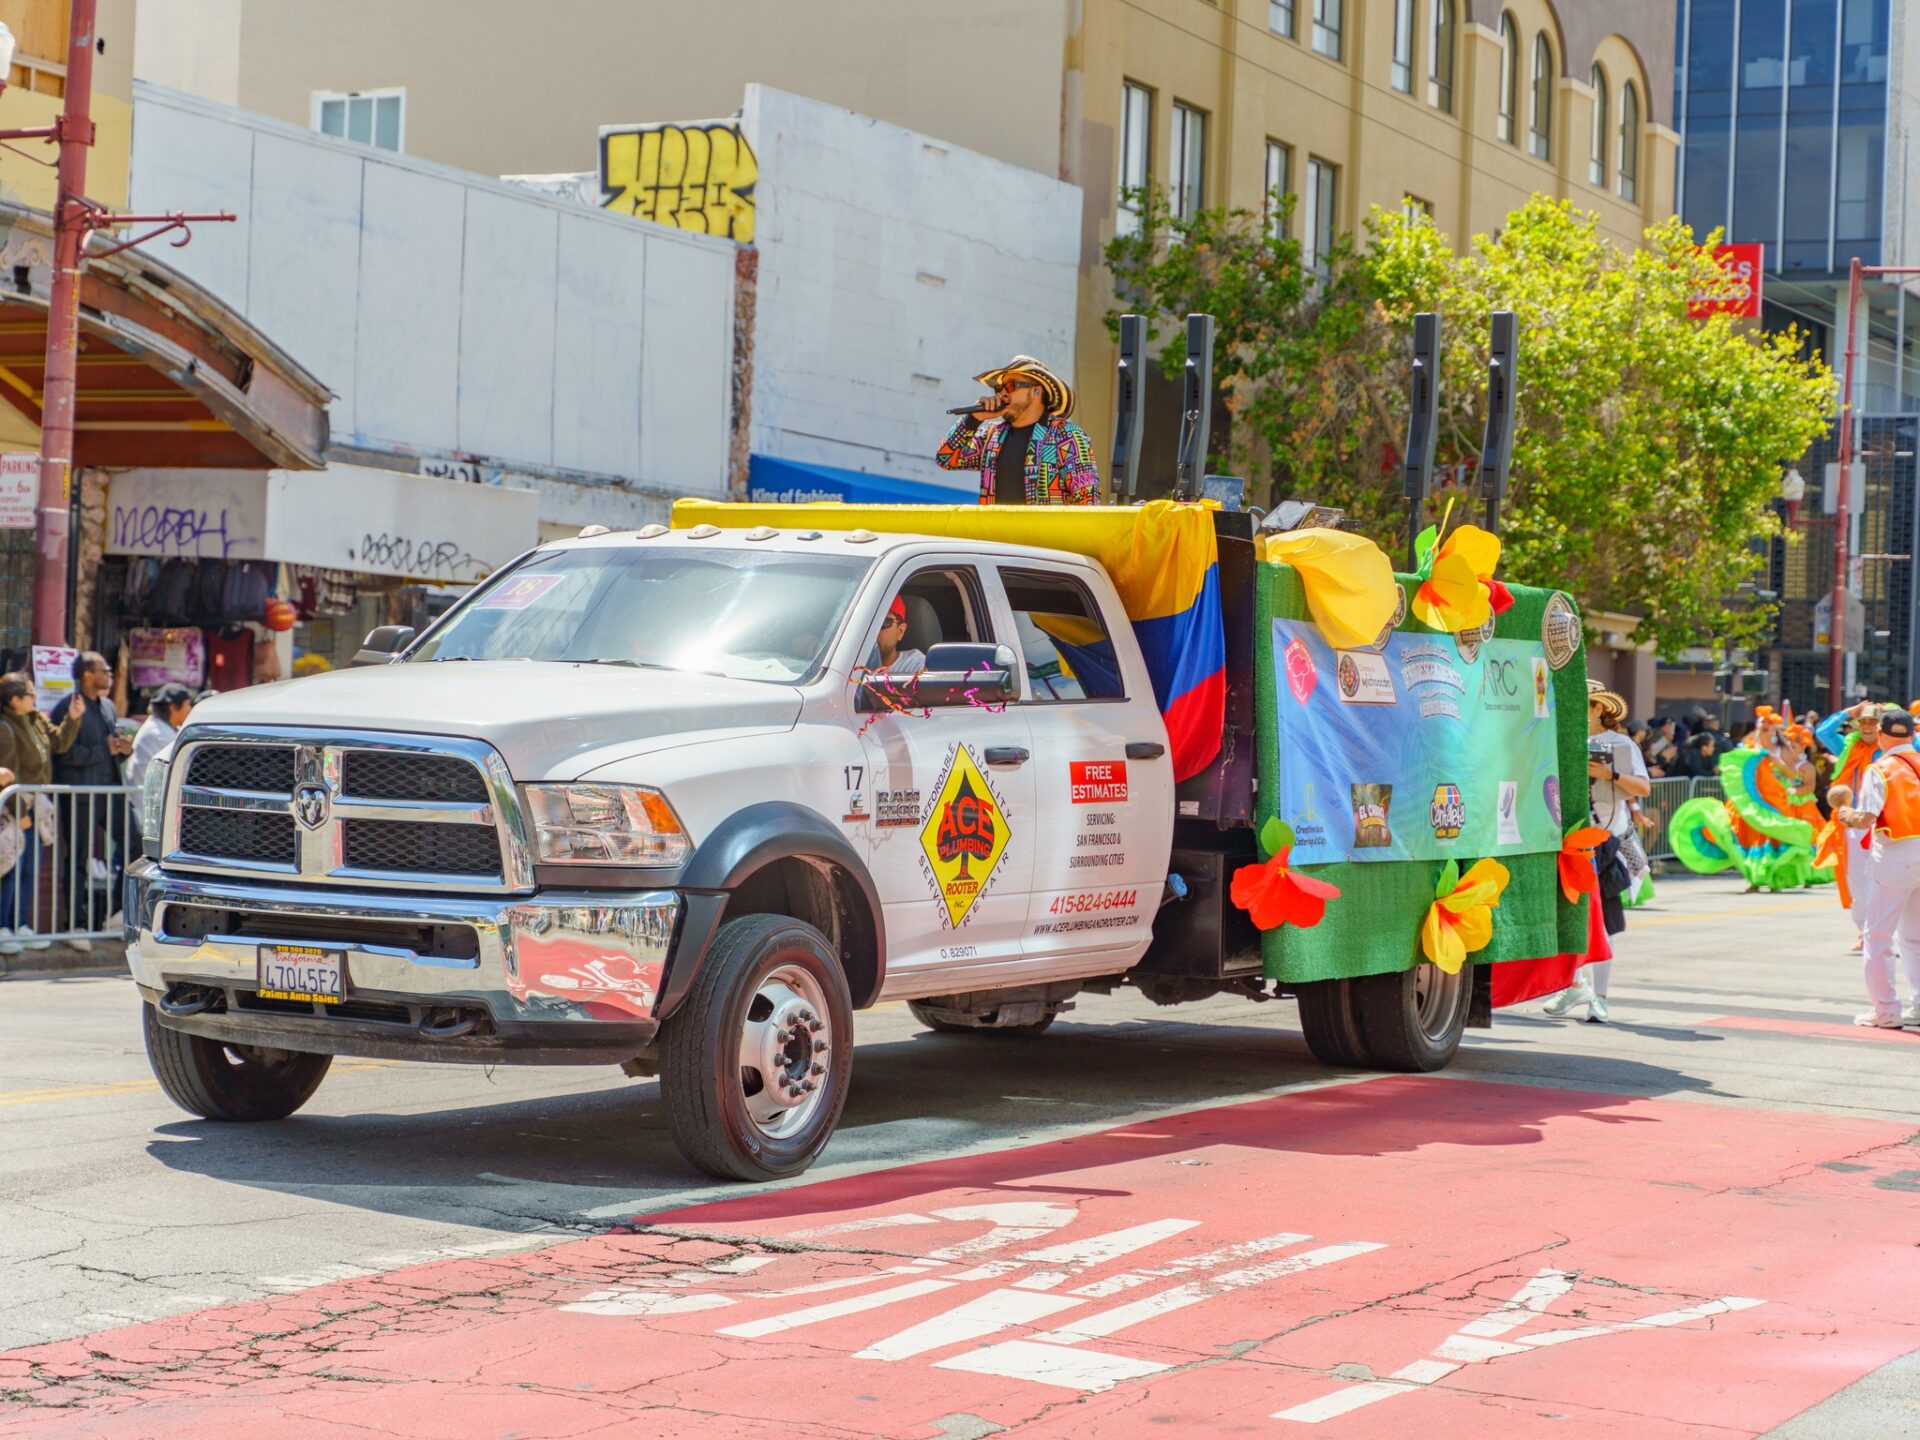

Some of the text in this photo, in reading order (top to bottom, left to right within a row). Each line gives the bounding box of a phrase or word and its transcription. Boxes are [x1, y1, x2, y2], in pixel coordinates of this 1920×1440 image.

[752, 487, 844, 504] King of fashions
[1479, 659, 1518, 698] ARC
[844, 765, 864, 791] 17
[1085, 764, 1113, 780] FREE
[920, 742, 1012, 826] AFFORDABLE QUALITY
[1072, 783, 1127, 799] ESTIMATES
[876, 788, 920, 804] RAM
[936, 795, 995, 846] ACE
[1086, 812, 1116, 826] SERVICING:
[1076, 832, 1122, 848] SAN FRANCISCO &
[938, 838, 992, 861] PLUMBING
[1069, 853, 1125, 869] SURROUNDING CITIES
[919, 852, 1010, 931] SERVICE REPAIR
[946, 881, 979, 895] ROOTER
[1049, 890, 1137, 914] 415-824-6444
[1033, 915, 1139, 936] WWW.ACEPLUMBINGANDROOTER.COM
[950, 945, 978, 958] 829071
[275, 953, 322, 967] California
[266, 965, 339, 994] 47045F2
[289, 991, 311, 1002] Auto
